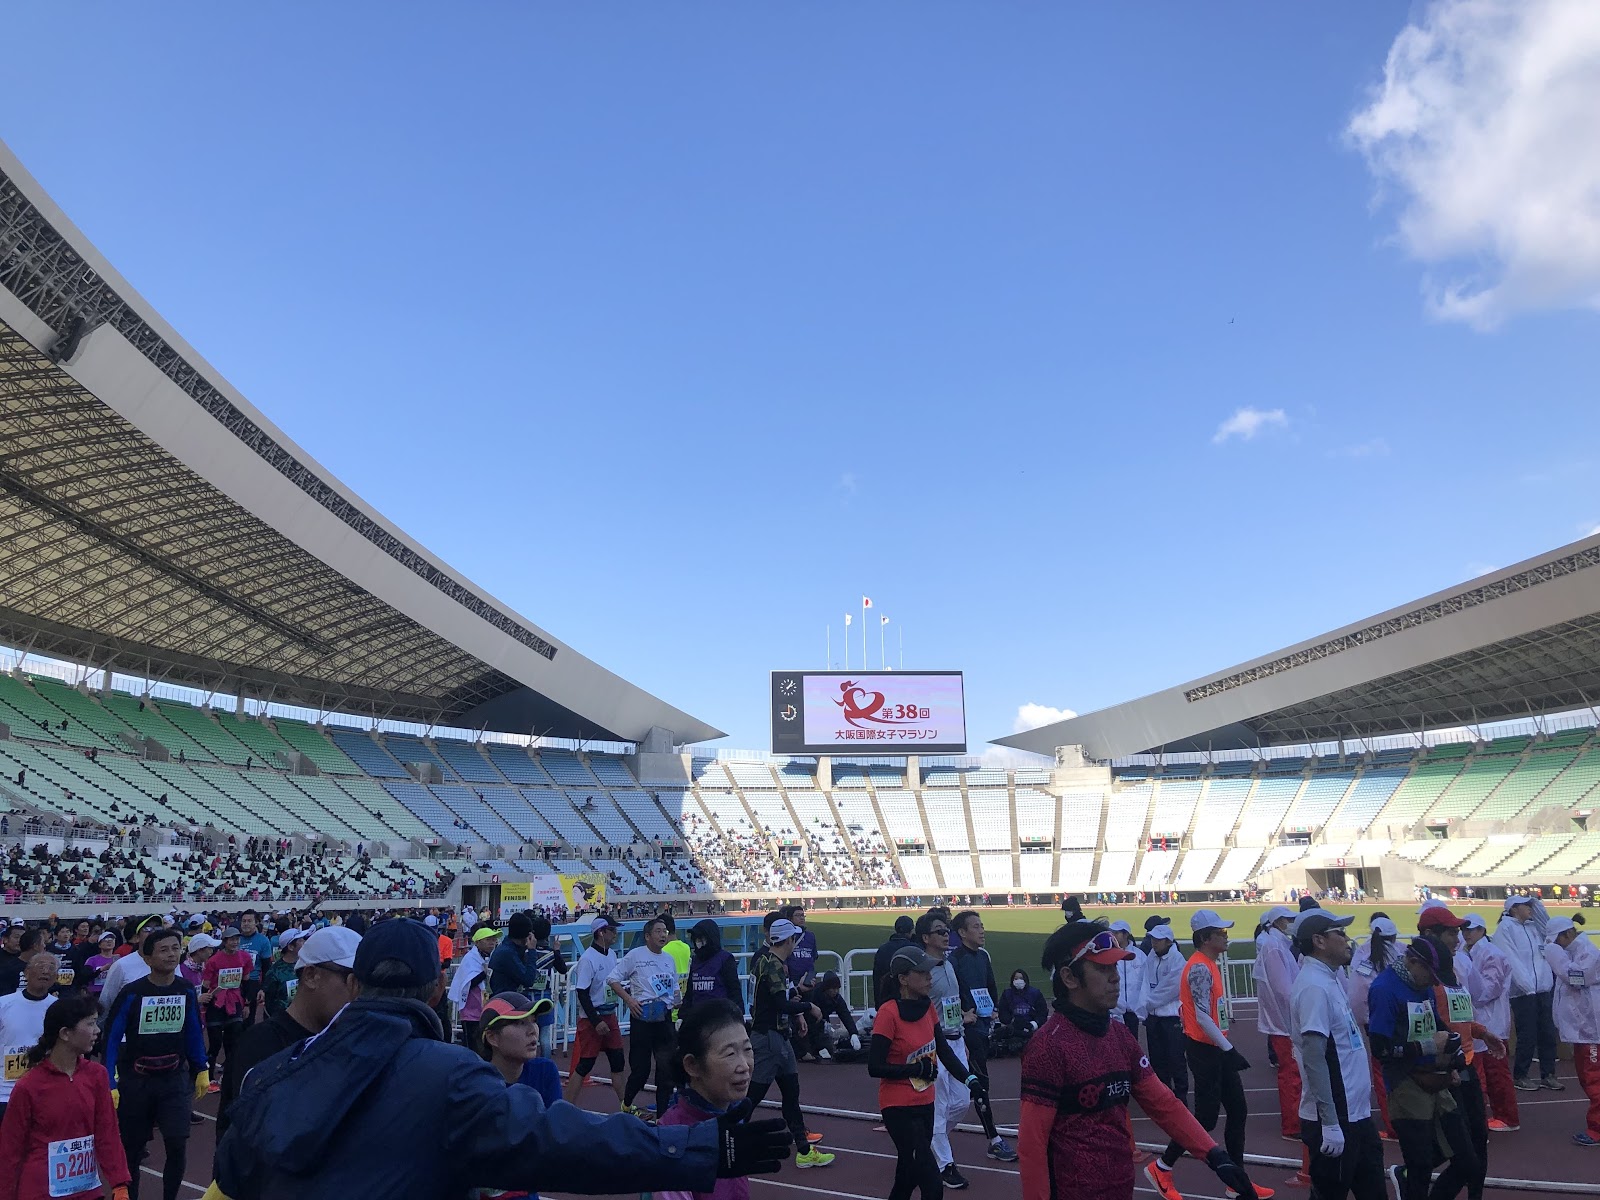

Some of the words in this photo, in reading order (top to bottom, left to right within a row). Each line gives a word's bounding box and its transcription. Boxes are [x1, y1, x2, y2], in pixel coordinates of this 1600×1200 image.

[882, 704, 930, 719] 第38回
[835, 730, 938, 740] 大阪国際女子マラソン
[492, 875, 498, 883] 4
[698, 981, 714, 990] STAFF
[145, 1006, 182, 1023] E13383
